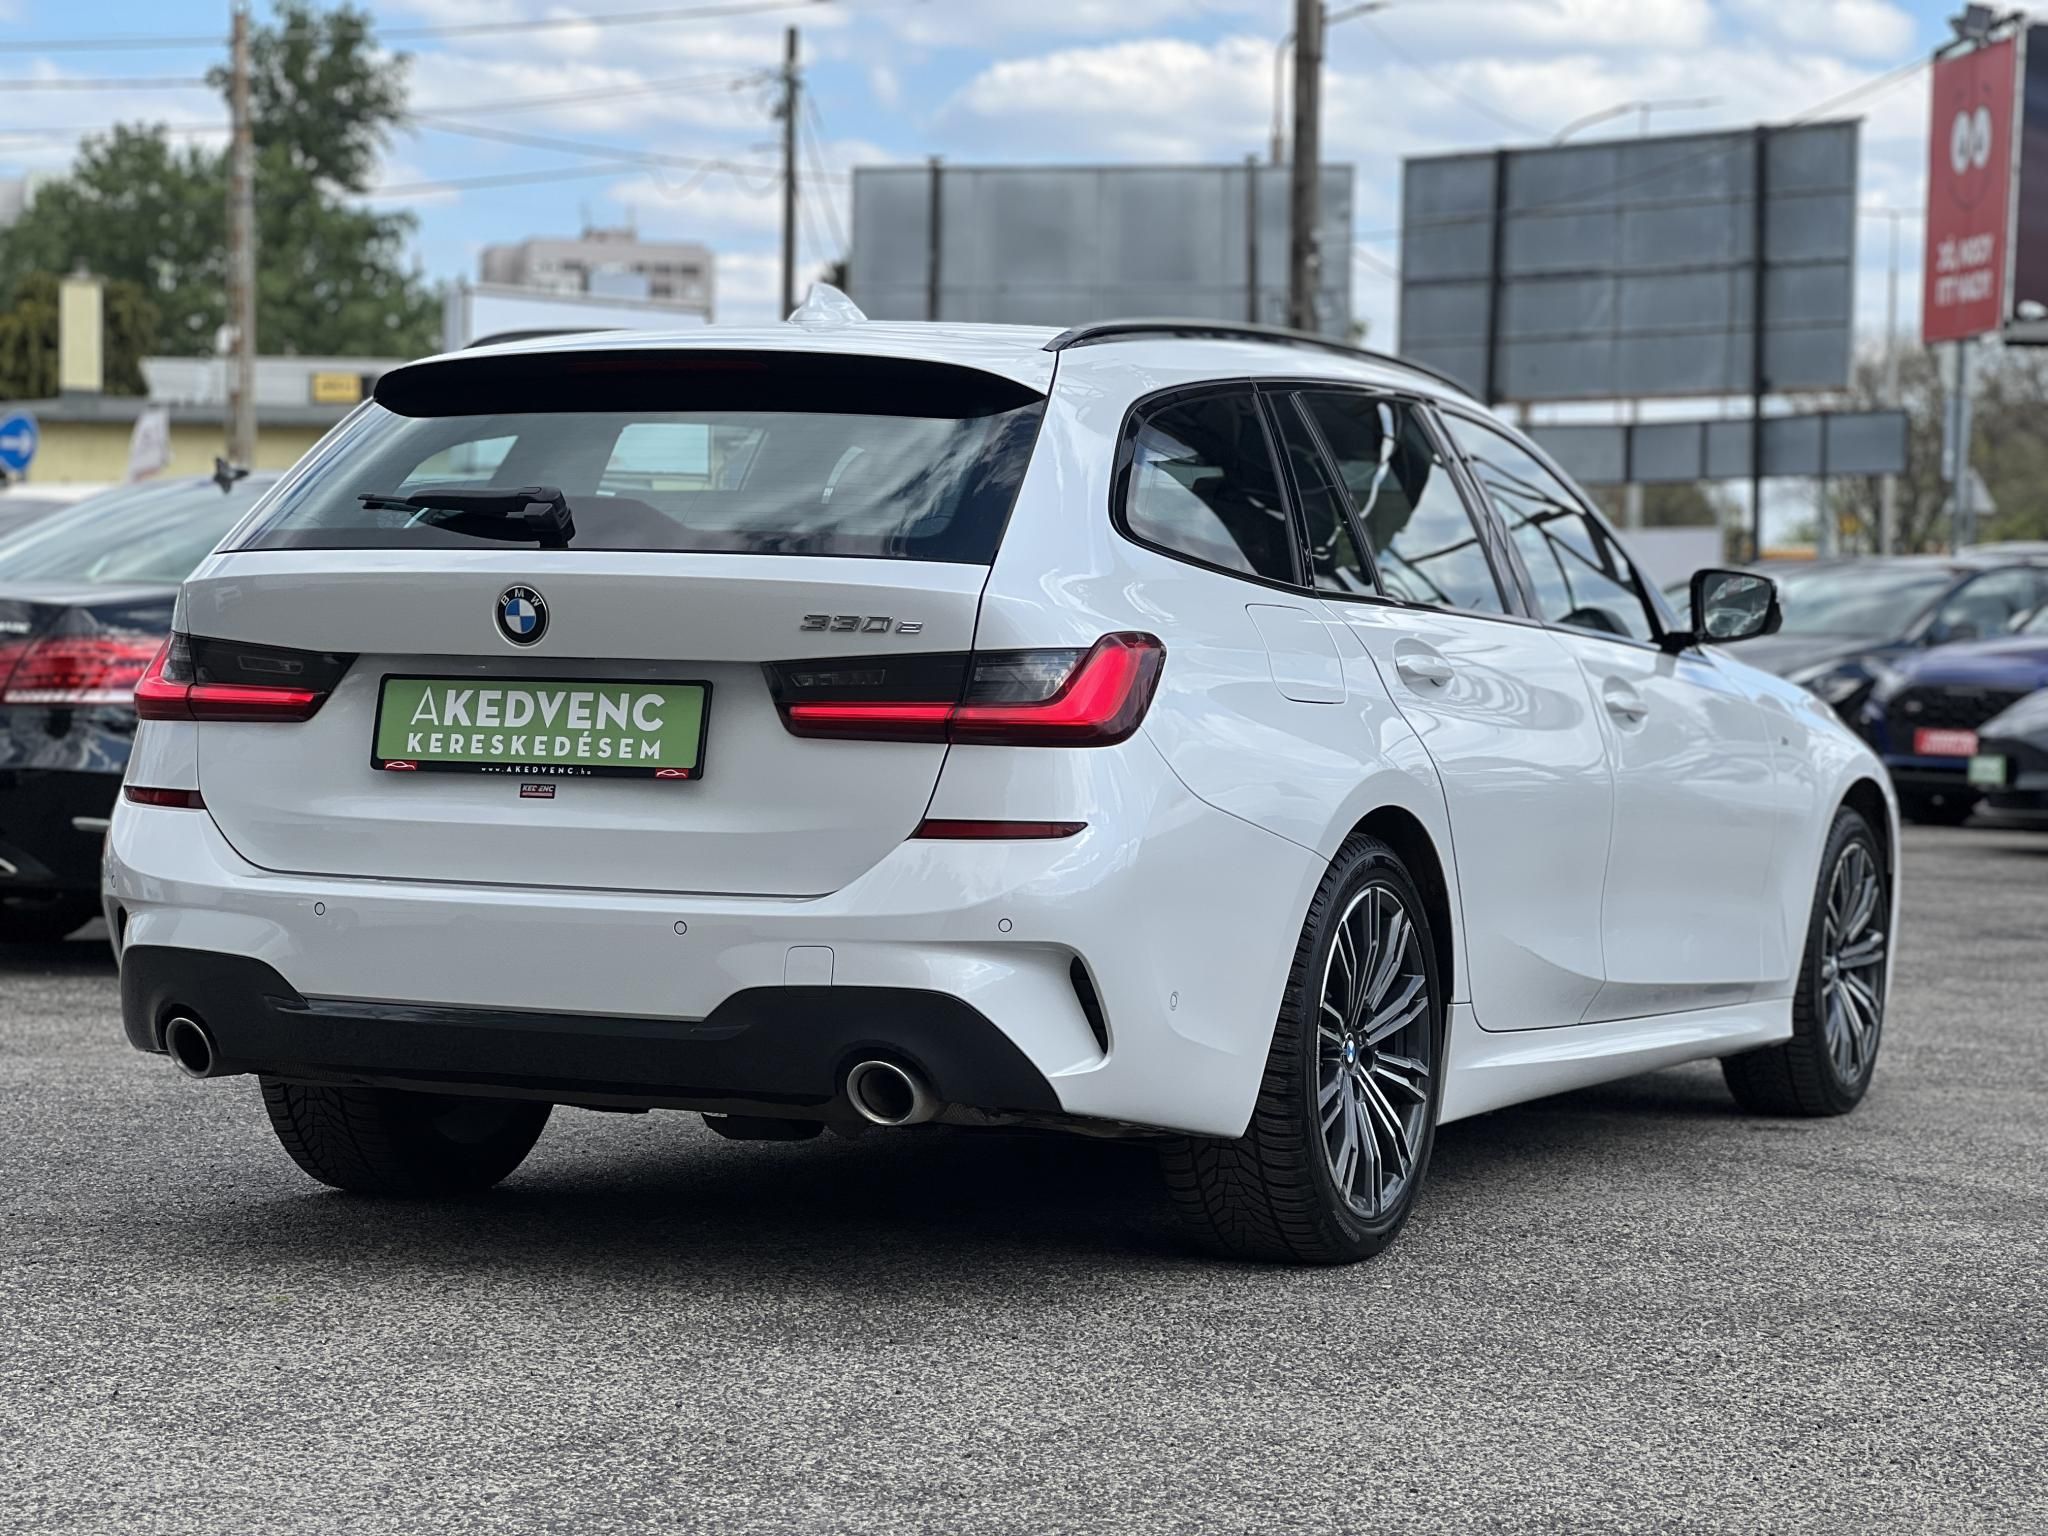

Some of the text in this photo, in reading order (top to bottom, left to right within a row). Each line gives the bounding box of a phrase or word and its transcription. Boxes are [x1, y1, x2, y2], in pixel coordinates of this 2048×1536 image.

[501, 588, 542, 607] BMW
[800, 614, 923, 634] 330e
[407, 731, 661, 760] KERESKEDÉSEM
[481, 765, 592, 775] www.AKEDVENC.hu
